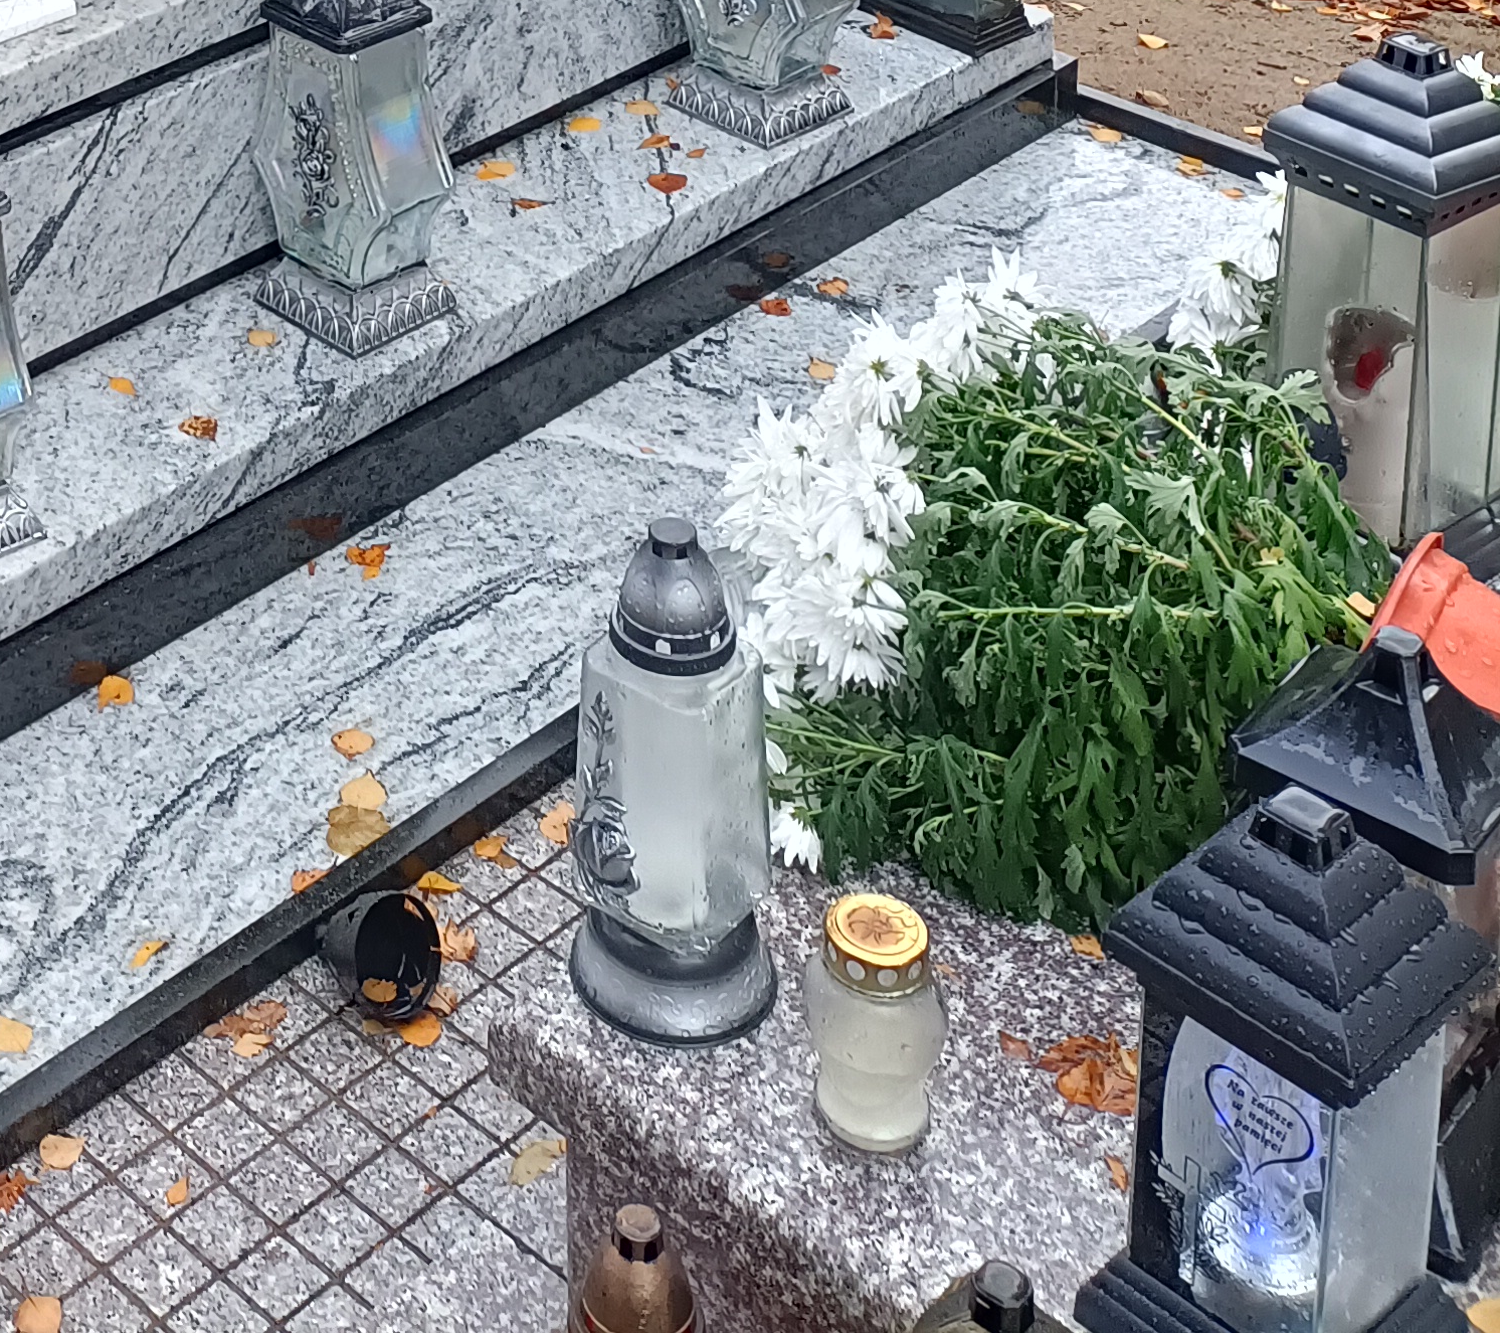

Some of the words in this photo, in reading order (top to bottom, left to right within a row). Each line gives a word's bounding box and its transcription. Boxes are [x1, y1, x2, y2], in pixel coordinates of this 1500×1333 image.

[1226, 1078, 1246, 1099] Na
[1250, 1095, 1294, 1131] zawsze
[1232, 1100, 1245, 1112] w
[1247, 1110, 1287, 1144] naszej
[1233, 1117, 1284, 1155] pamięci
